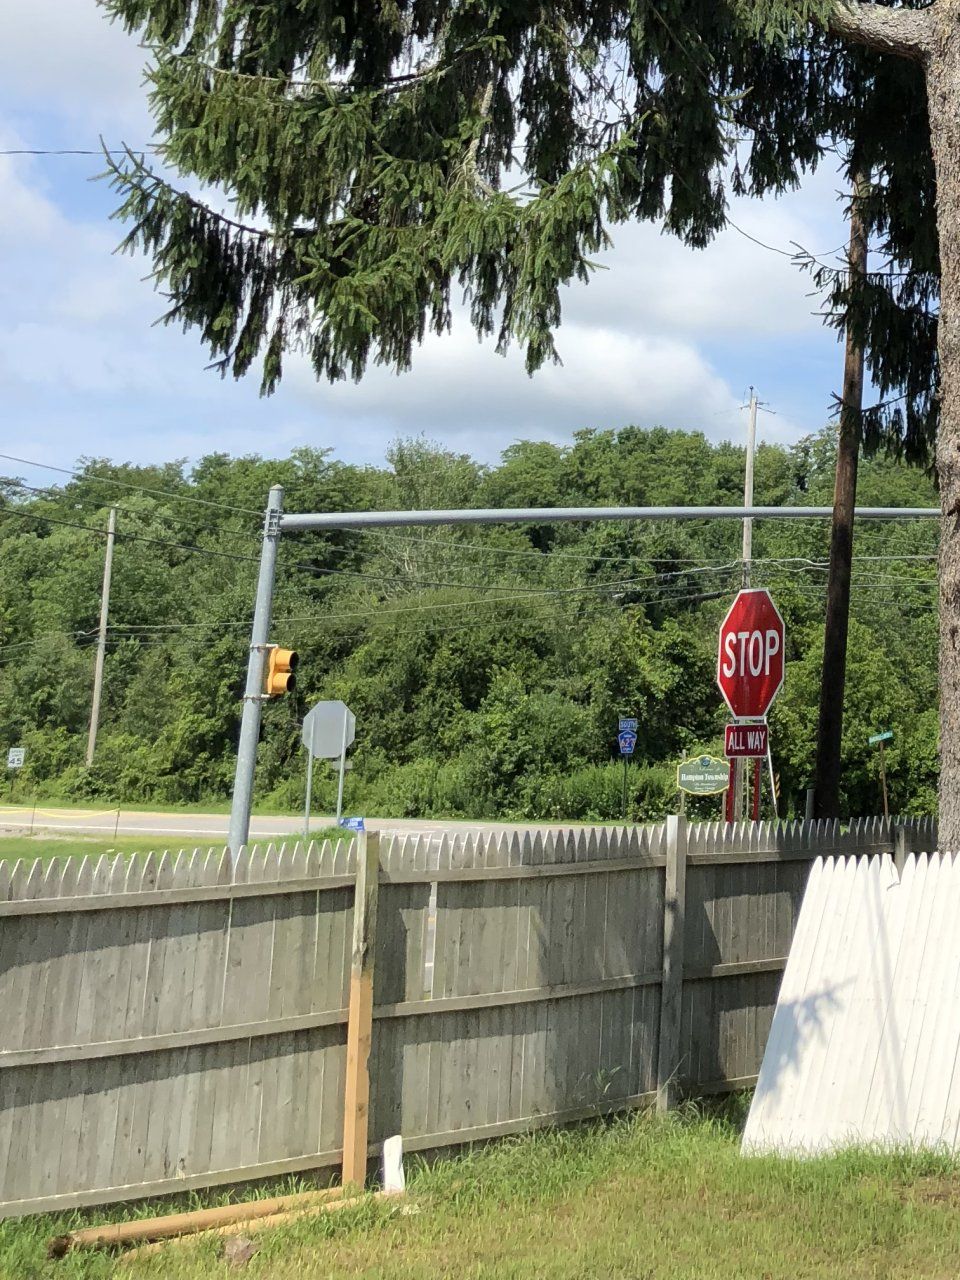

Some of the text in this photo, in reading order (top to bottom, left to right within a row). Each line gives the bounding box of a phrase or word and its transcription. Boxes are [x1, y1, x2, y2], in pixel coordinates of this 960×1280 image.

[722, 629, 780, 678] STOP
[728, 730, 766, 750] ALL WAY
[9, 757, 22, 765] 45
